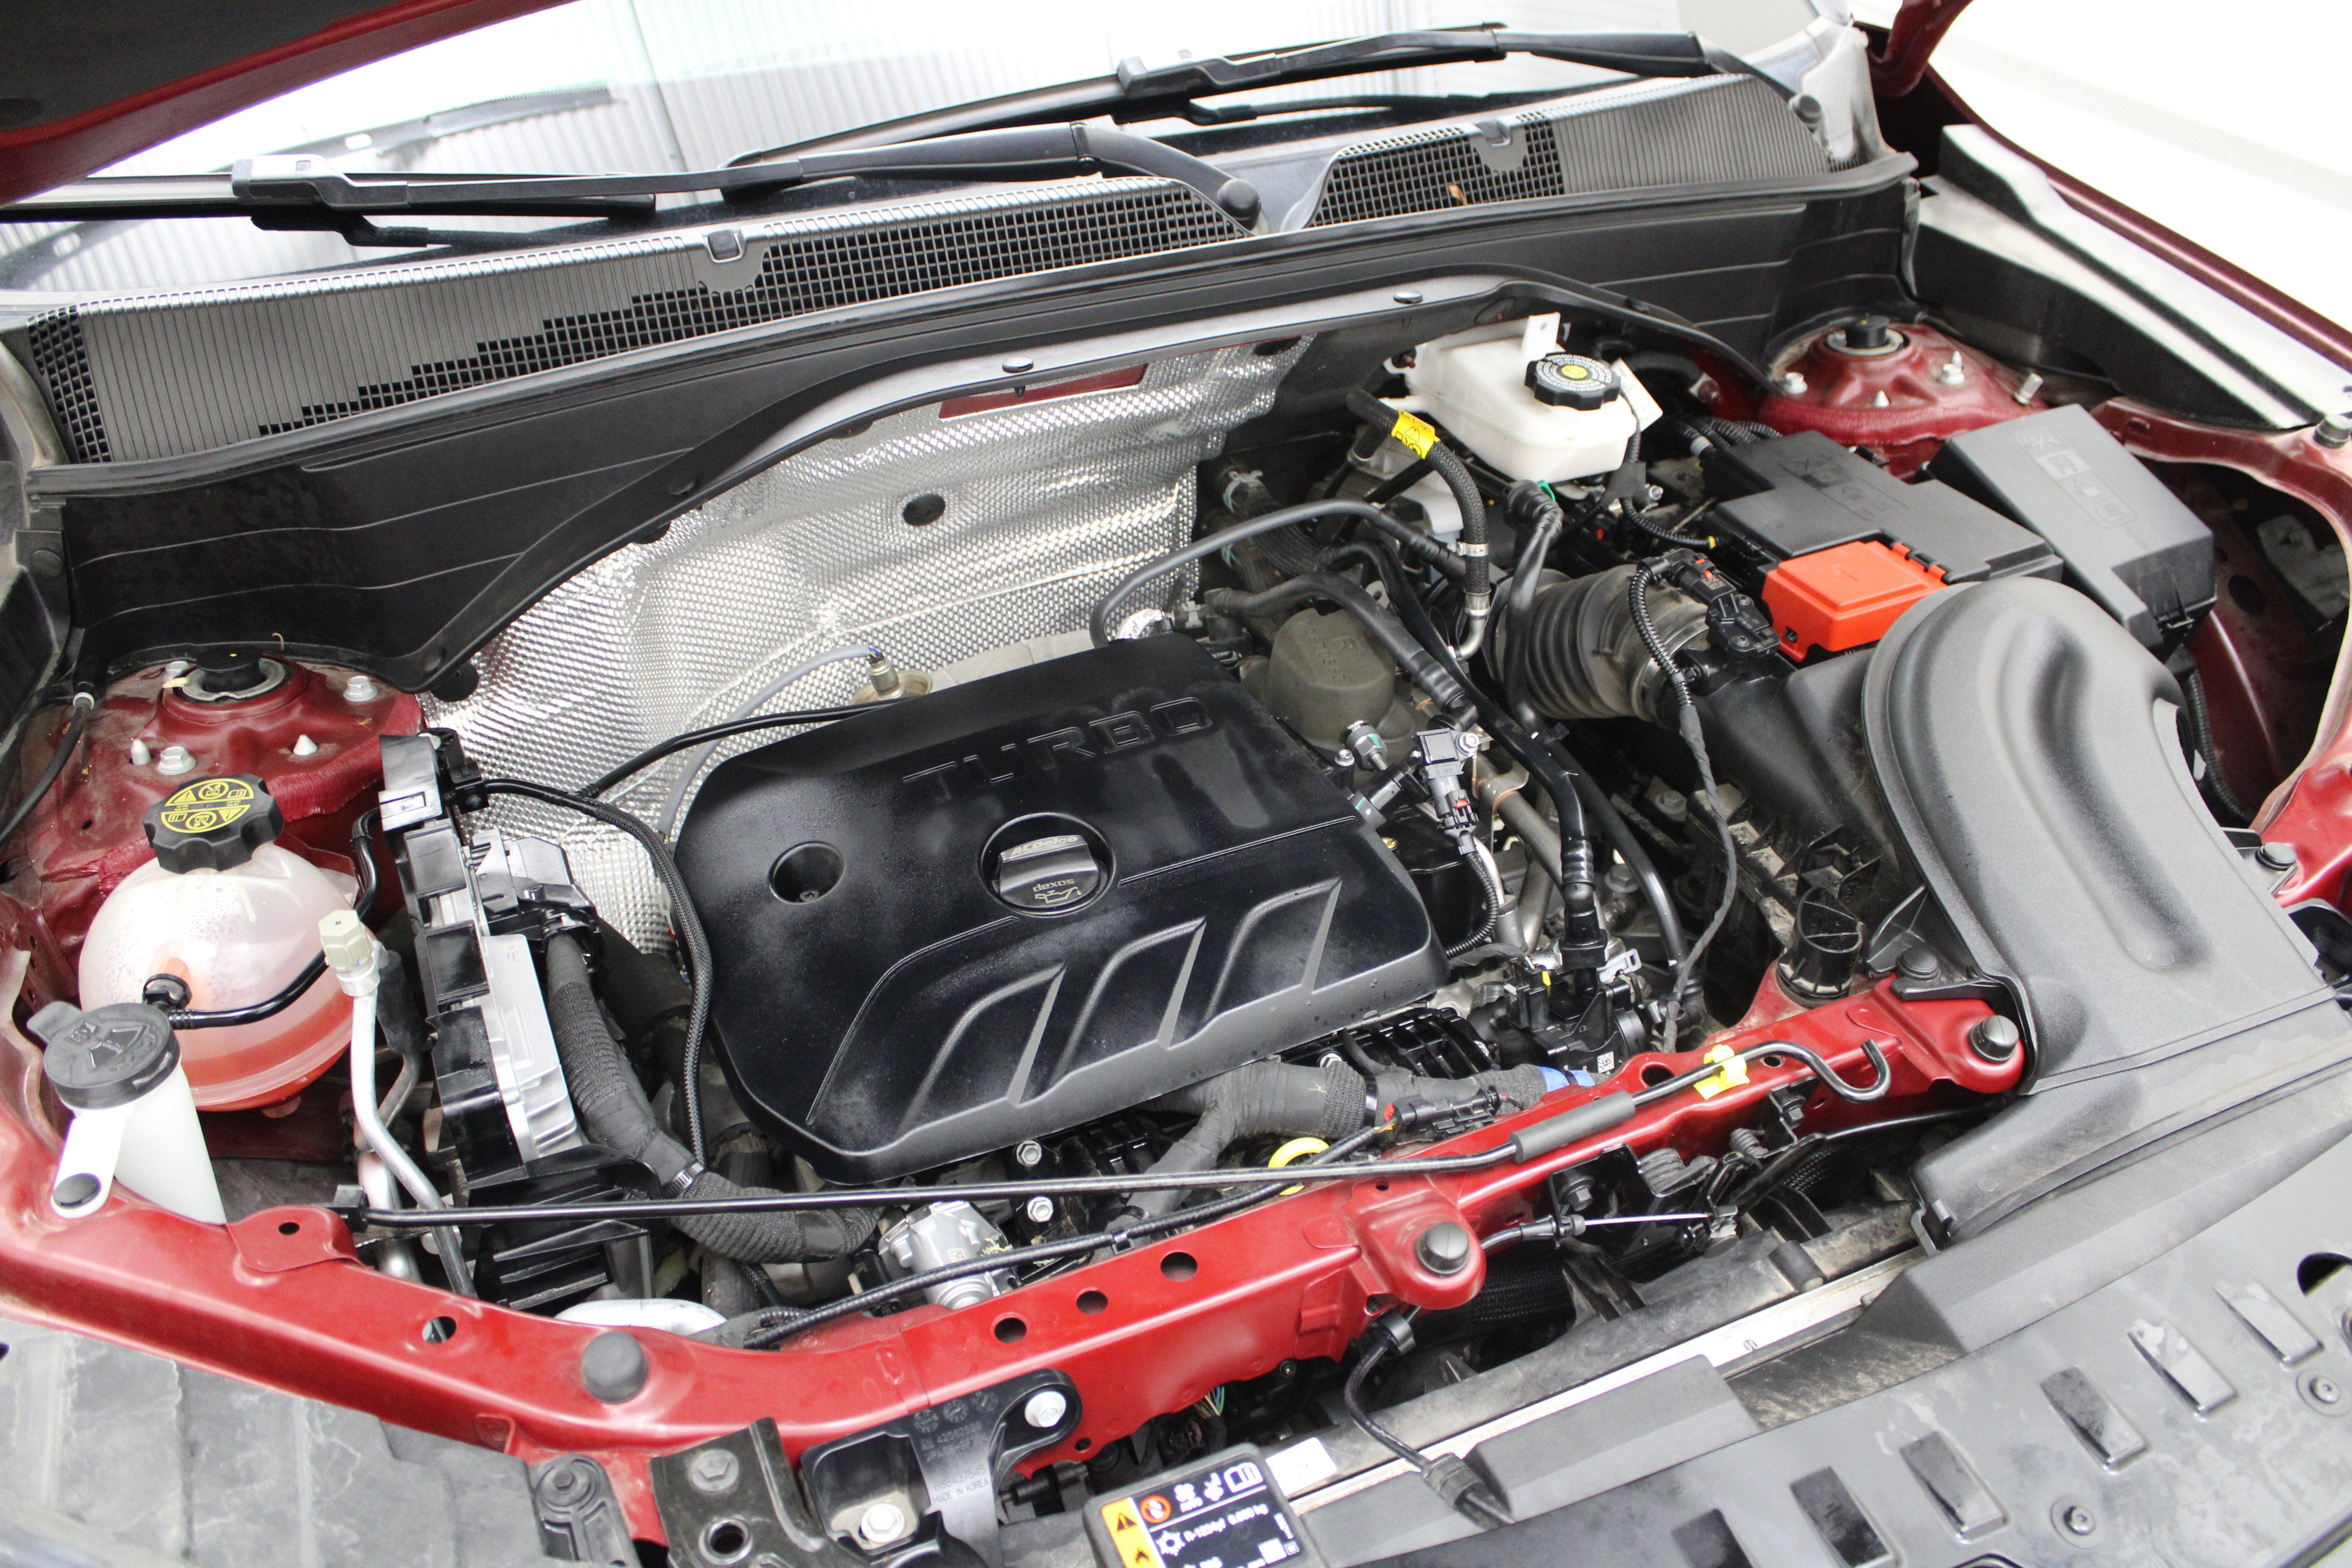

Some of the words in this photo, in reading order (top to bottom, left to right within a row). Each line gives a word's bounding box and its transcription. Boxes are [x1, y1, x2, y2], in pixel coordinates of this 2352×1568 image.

[902, 697, 1212, 800] TURBO
[1011, 836, 1078, 858] ACDelco
[1033, 879, 1075, 892] dexos
[932, 1491, 953, 1501] MADE
[966, 1479, 989, 1491] KOREA
